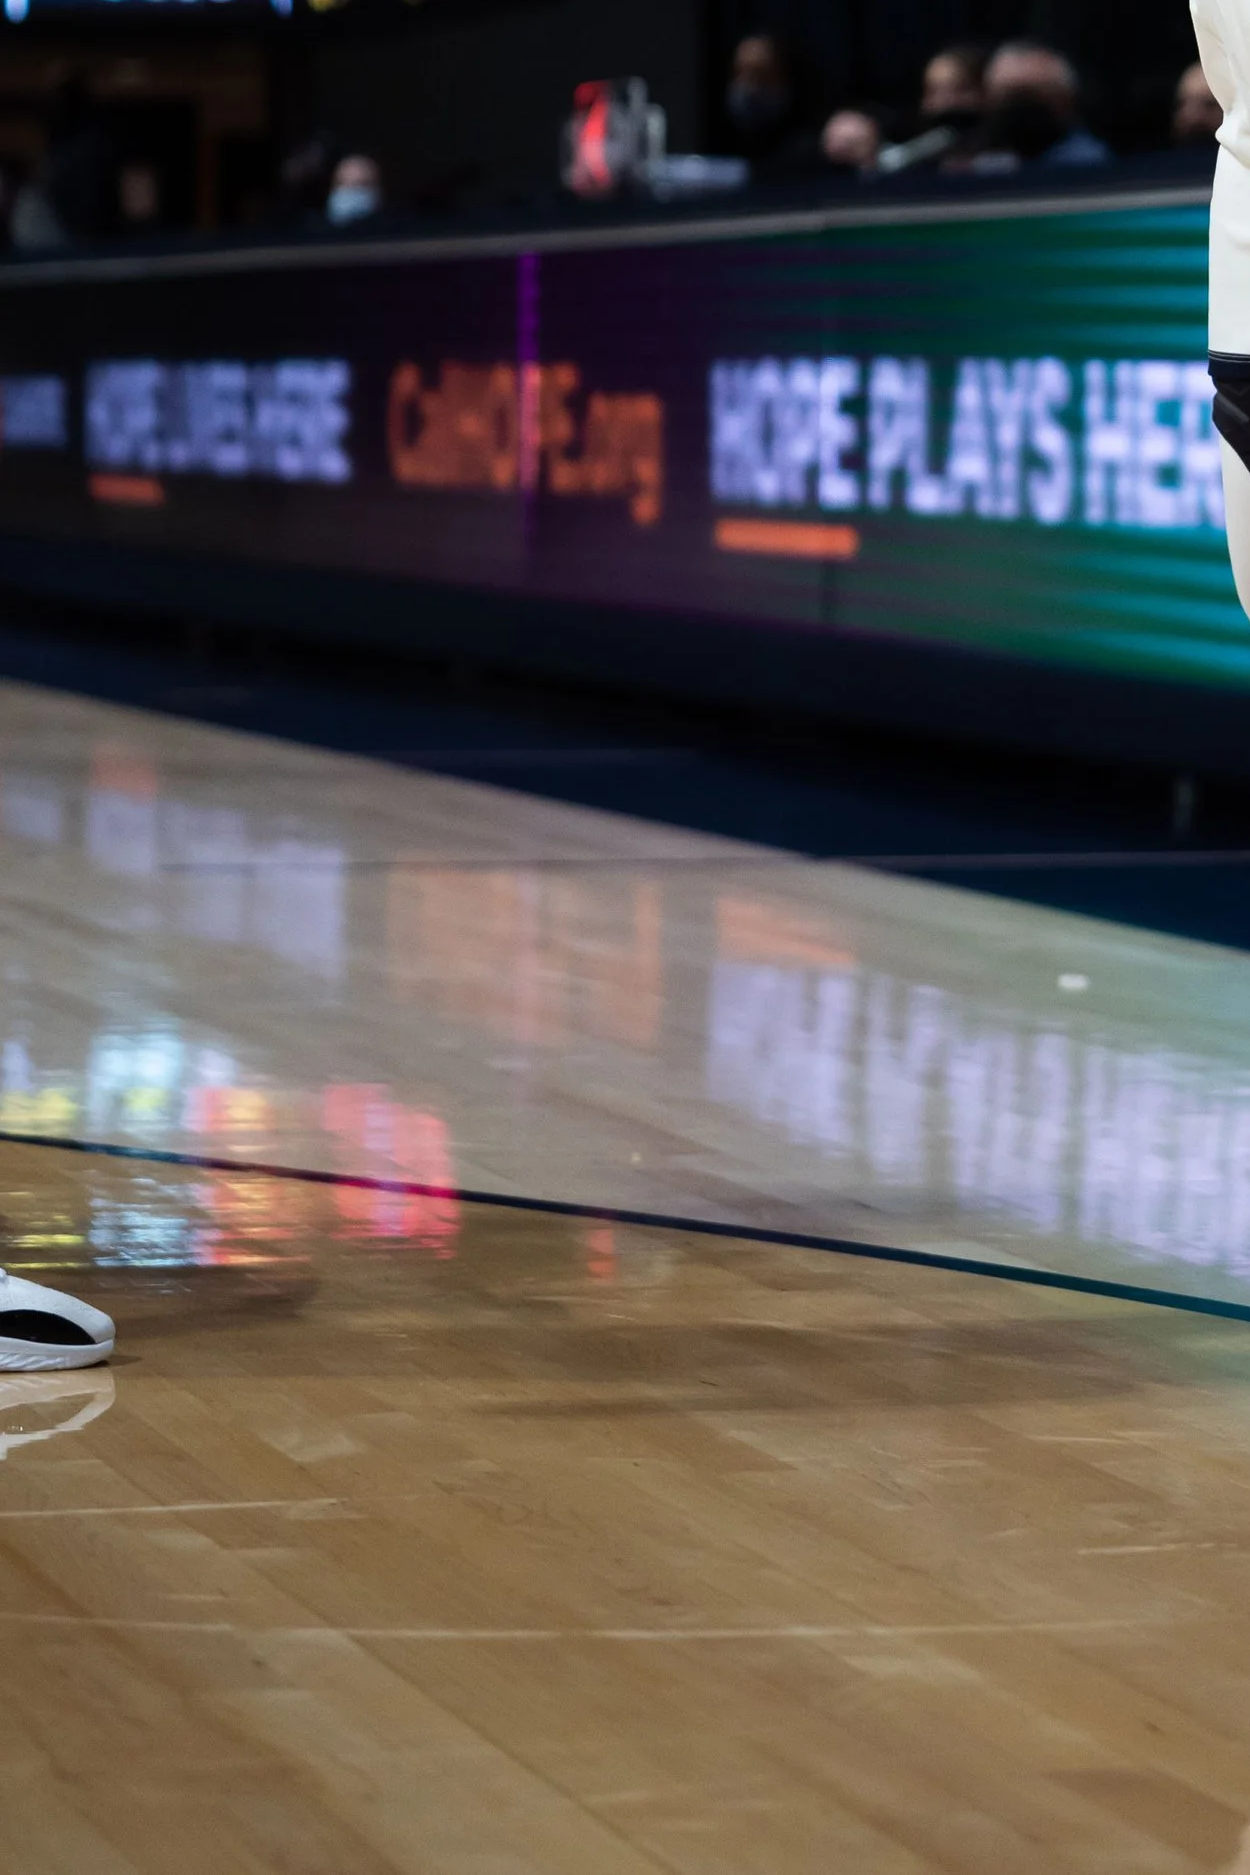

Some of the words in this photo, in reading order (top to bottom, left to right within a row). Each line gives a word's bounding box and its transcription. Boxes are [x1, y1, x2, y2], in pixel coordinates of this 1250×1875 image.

[709, 355, 861, 512] HOPE
[866, 357, 1072, 526] PLAYS
[1083, 359, 1227, 529] HER
